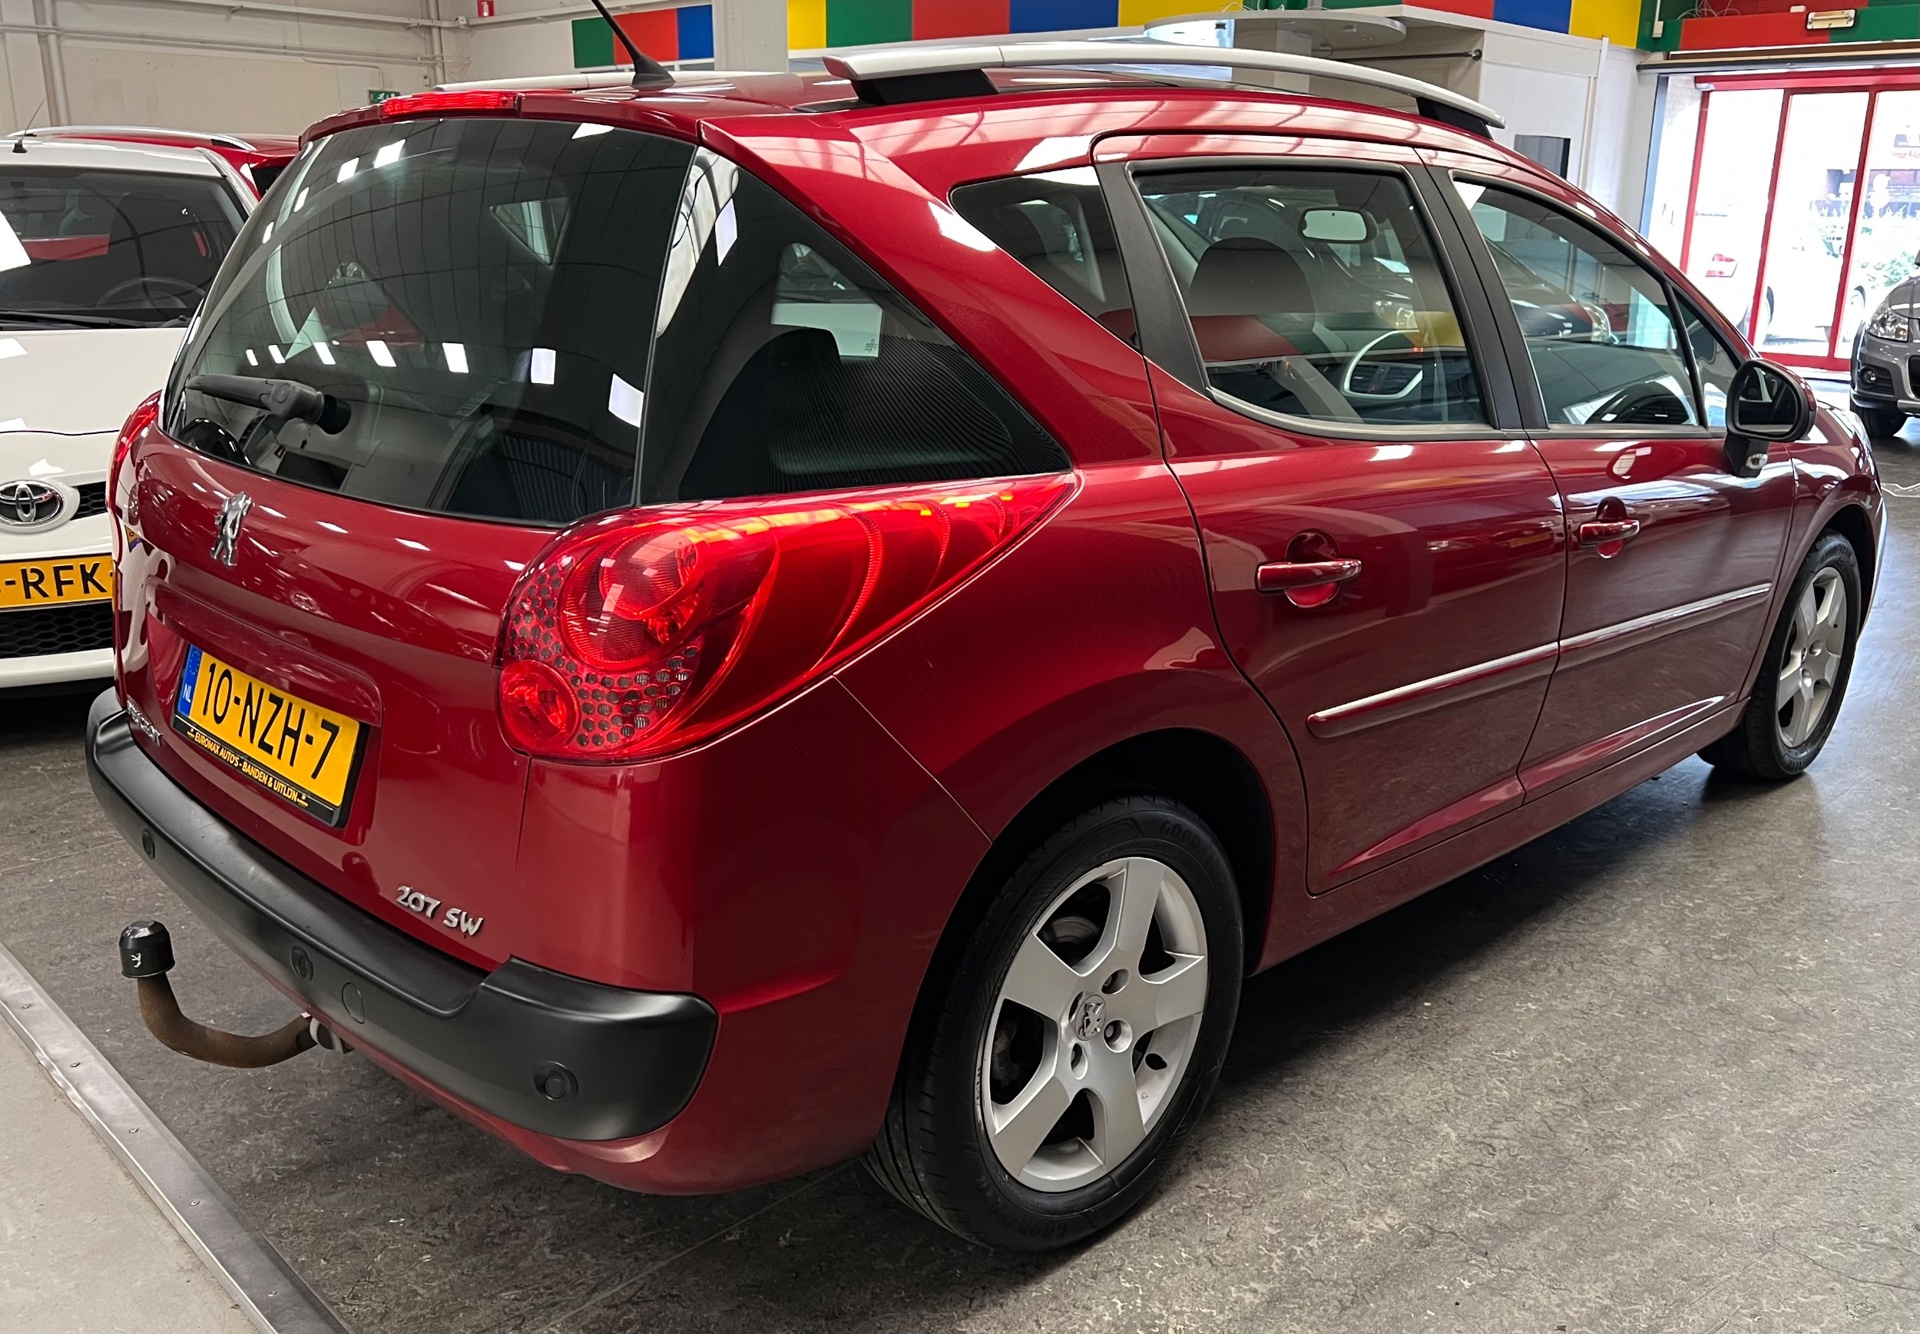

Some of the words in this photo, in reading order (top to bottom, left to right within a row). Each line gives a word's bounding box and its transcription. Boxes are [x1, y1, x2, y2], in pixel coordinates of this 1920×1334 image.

[183, 683, 191, 703] NL
[202, 663, 341, 780] 10-NZH-7
[194, 732, 221, 754] EUROMAX
[219, 748, 239, 767] AUTO'S
[241, 761, 268, 785] BANDEN
[396, 885, 442, 919] 207
[442, 907, 484, 936] SW
